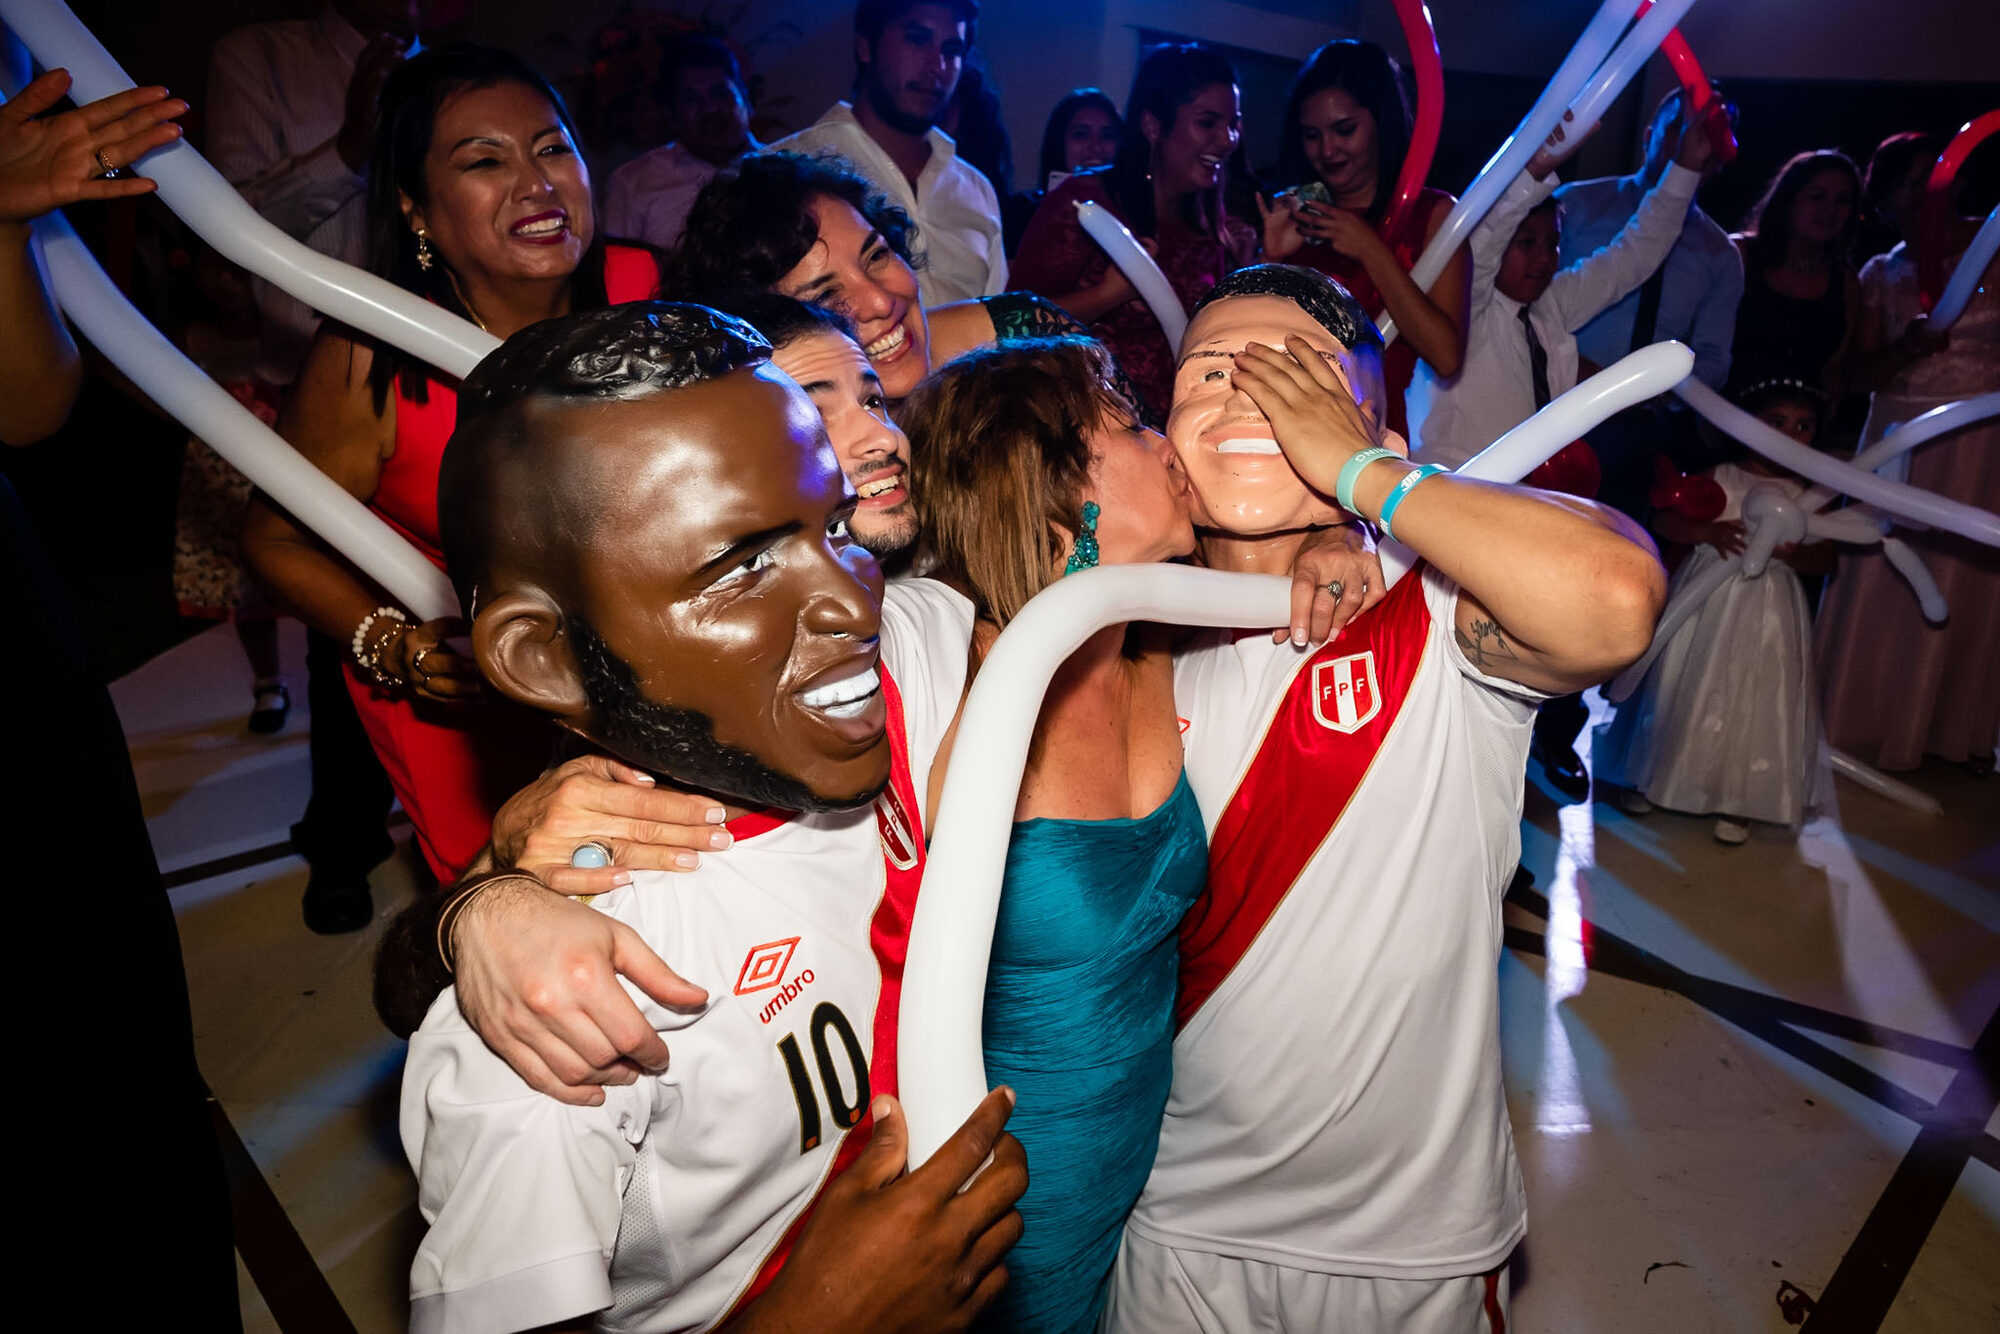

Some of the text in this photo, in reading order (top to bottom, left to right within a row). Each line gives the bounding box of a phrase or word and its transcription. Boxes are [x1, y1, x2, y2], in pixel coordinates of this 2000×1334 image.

[1323, 678, 1365, 700] FPF
[759, 968, 815, 1024] umbro
[776, 1001, 871, 1156] 10
